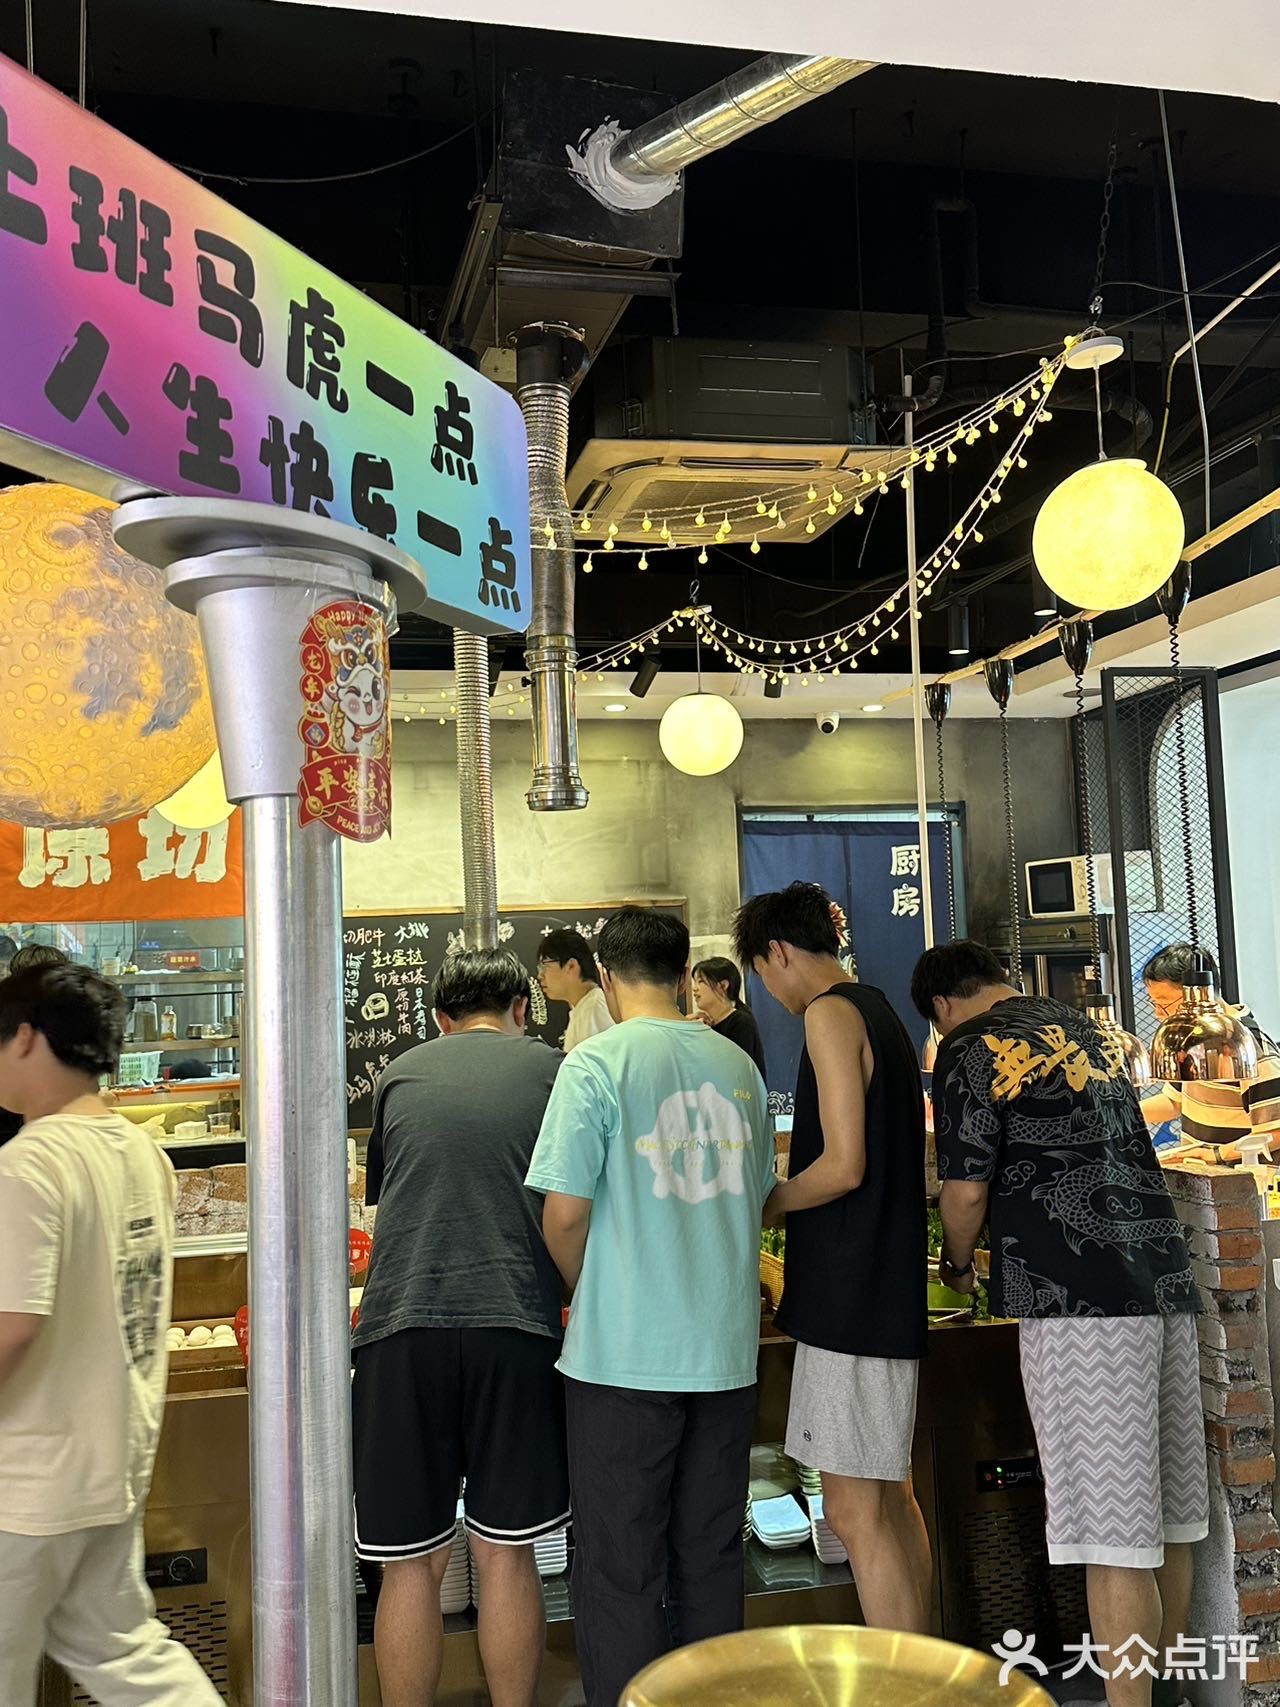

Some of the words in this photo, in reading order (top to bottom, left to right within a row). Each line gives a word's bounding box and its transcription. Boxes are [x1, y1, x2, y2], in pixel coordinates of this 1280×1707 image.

[44, 321, 522, 613] 人生快乐一点
[327, 610, 356, 625] Happy
[336, 815, 360, 833] PEACE
[890, 845, 921, 917] 厨房
